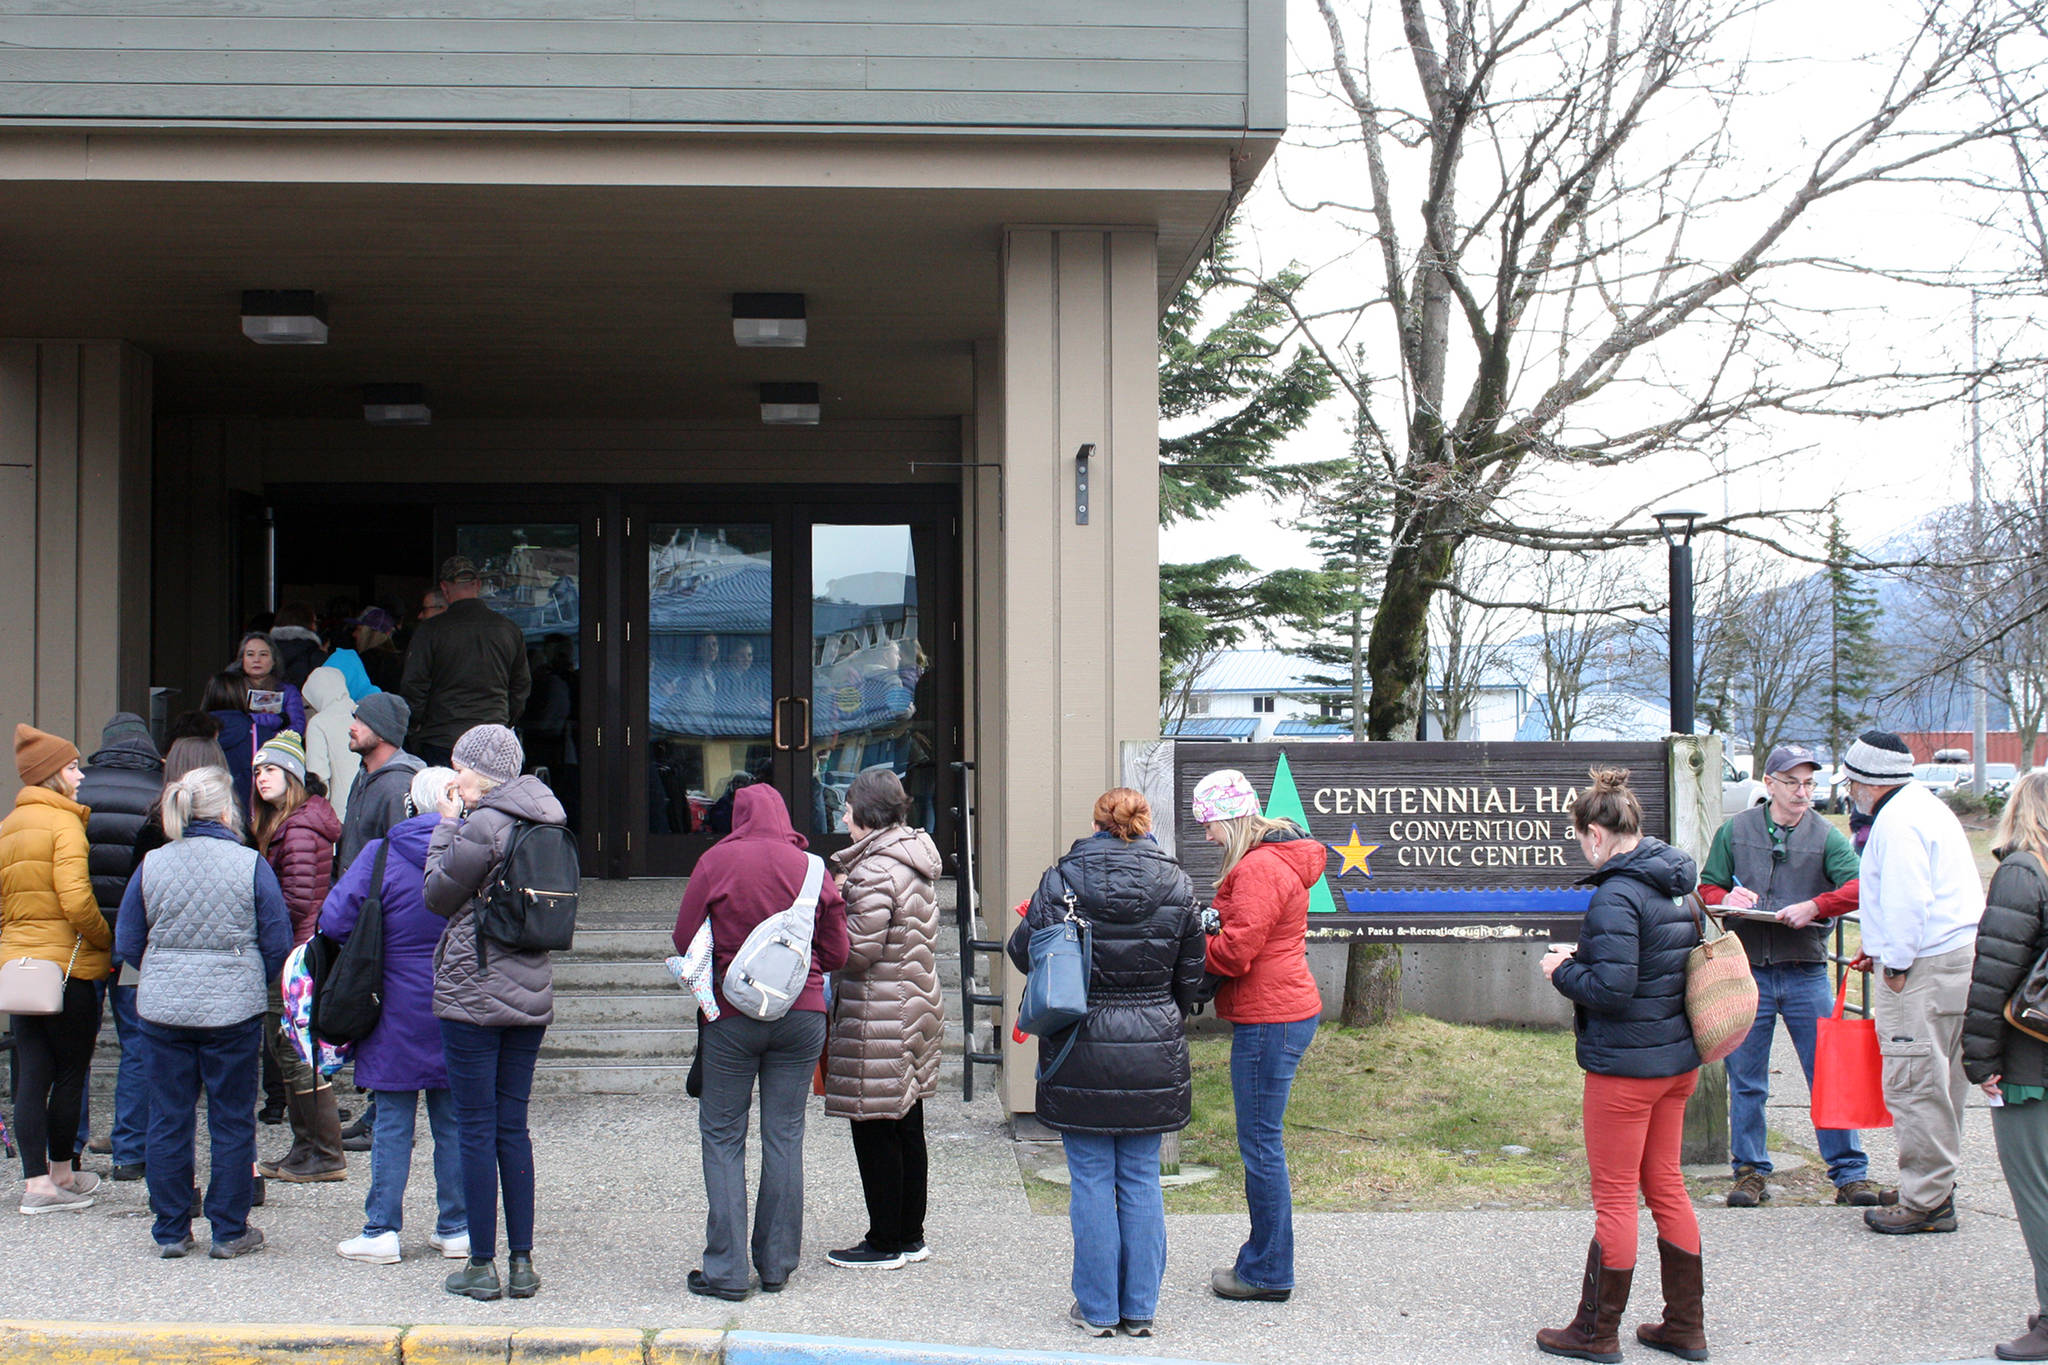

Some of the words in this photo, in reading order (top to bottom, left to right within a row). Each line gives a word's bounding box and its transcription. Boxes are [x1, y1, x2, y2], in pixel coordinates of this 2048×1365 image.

[1313, 787, 1525, 814] CENTENNIAL
[1533, 786, 1592, 813] HA
[1389, 820, 1551, 842] CONVENTION
[1398, 845, 1462, 867] CIVIC
[1471, 845, 1567, 867] CENTER
[1367, 926, 1394, 936] Parks
